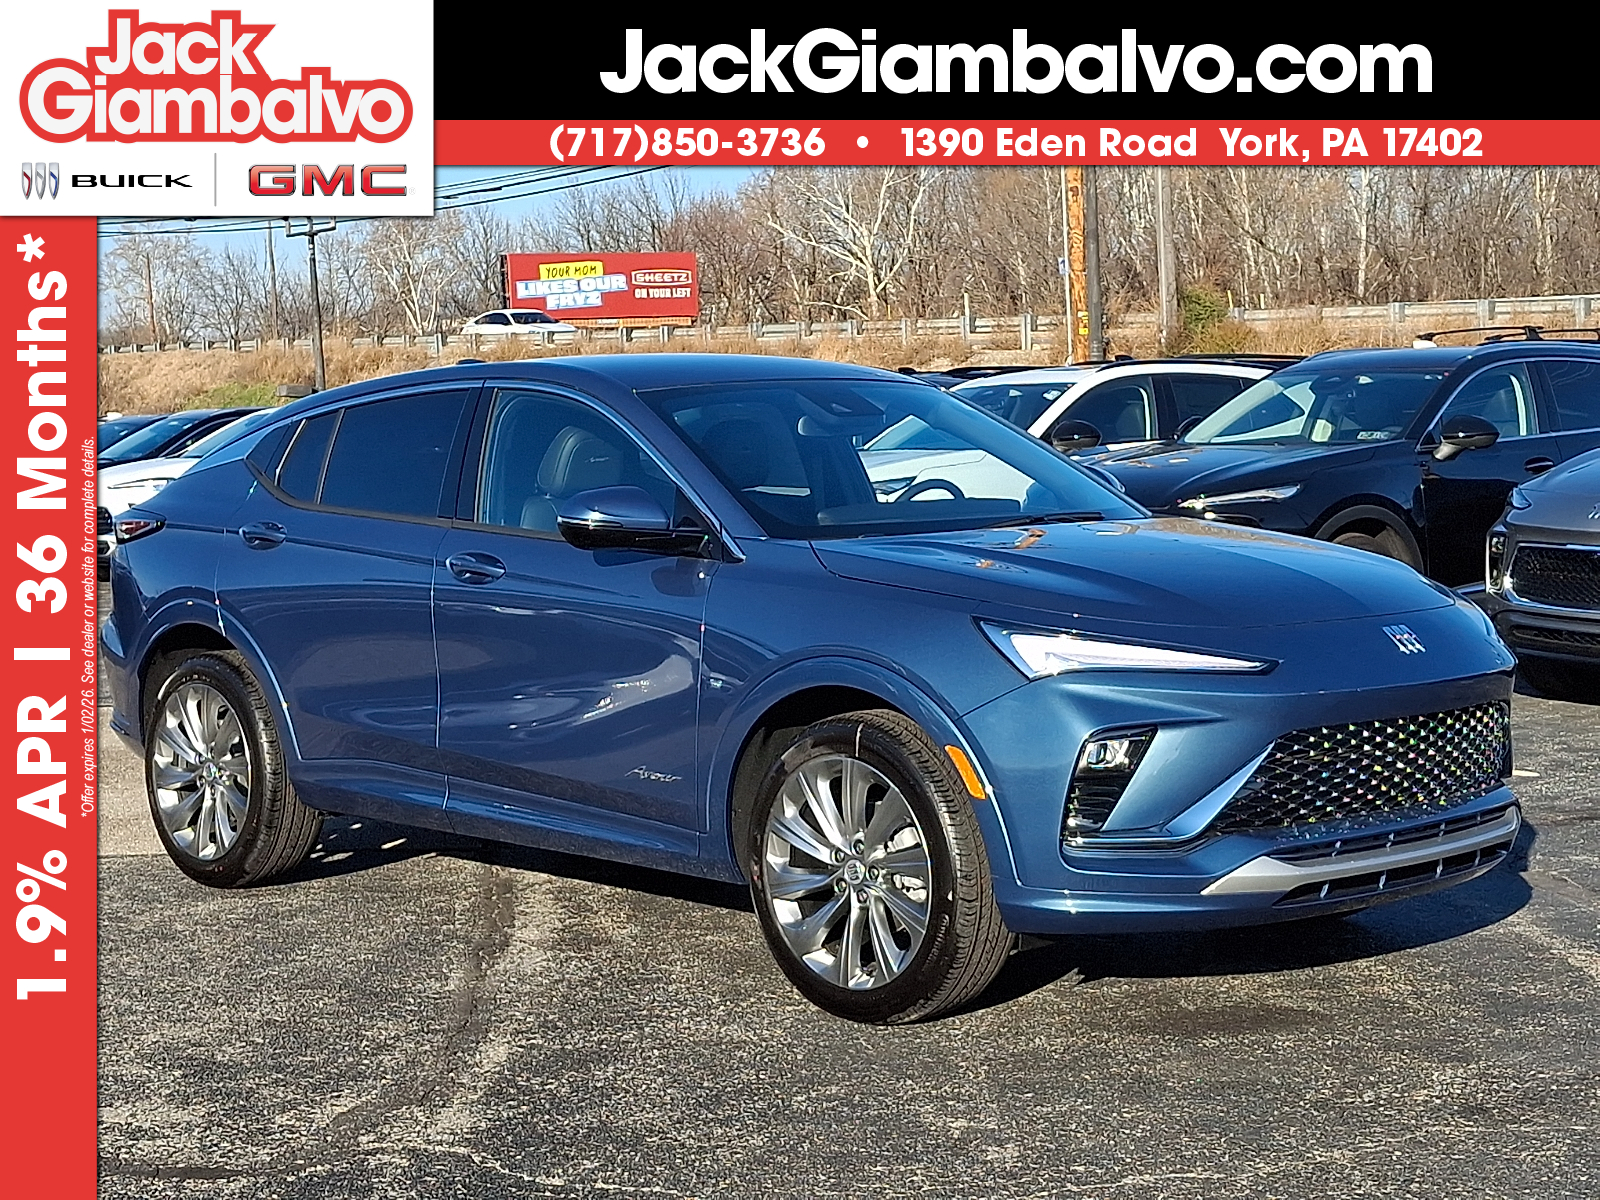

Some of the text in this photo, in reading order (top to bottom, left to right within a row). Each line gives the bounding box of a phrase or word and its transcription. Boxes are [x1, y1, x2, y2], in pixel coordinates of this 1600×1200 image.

[545, 265, 598, 279] YOUR MOM
[635, 272, 689, 283] SHEETZ
[517, 275, 627, 298] LIKES OUR
[634, 287, 692, 298] ON YOUR LEFT
[550, 292, 601, 309] FRYZ
